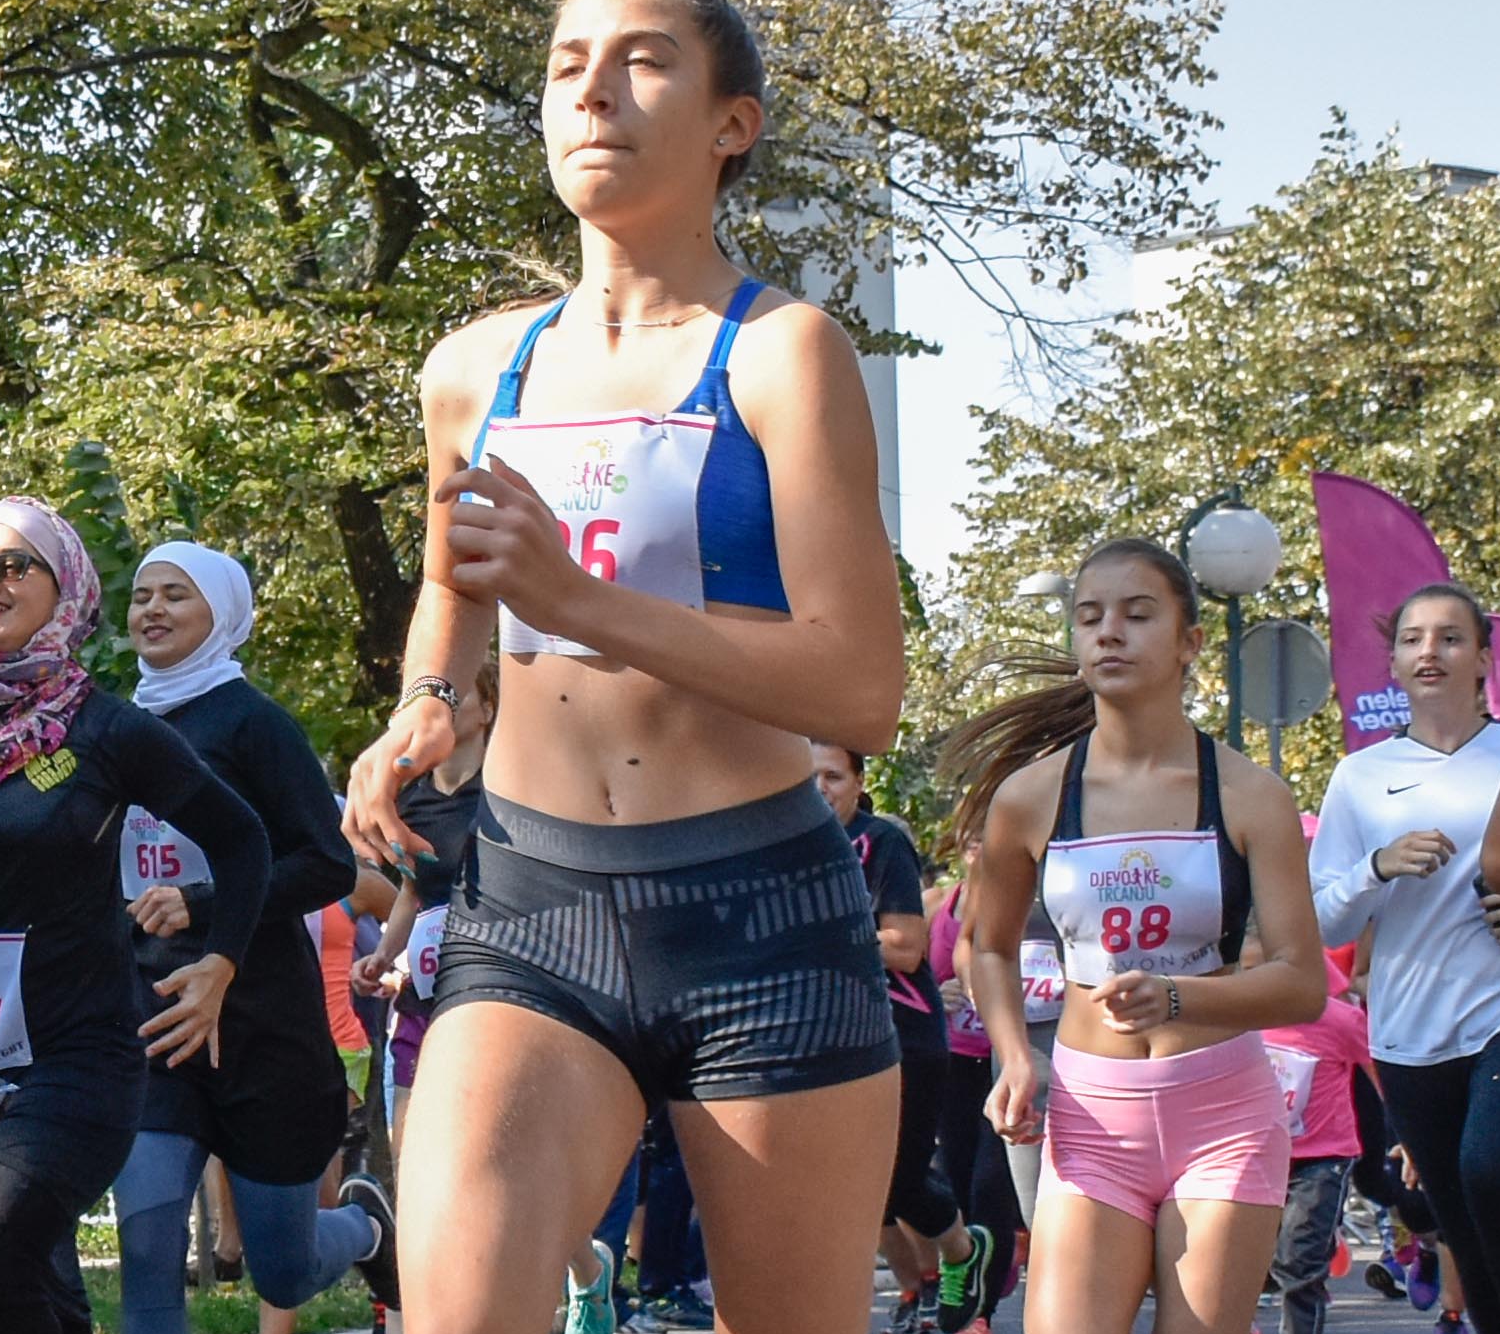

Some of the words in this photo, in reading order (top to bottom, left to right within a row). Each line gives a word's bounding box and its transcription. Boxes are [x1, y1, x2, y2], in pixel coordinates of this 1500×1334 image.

[557, 519, 621, 582] 6
[136, 843, 181, 879] 615
[1100, 904, 1171, 954] 88
[1106, 953, 1175, 973] AVON
